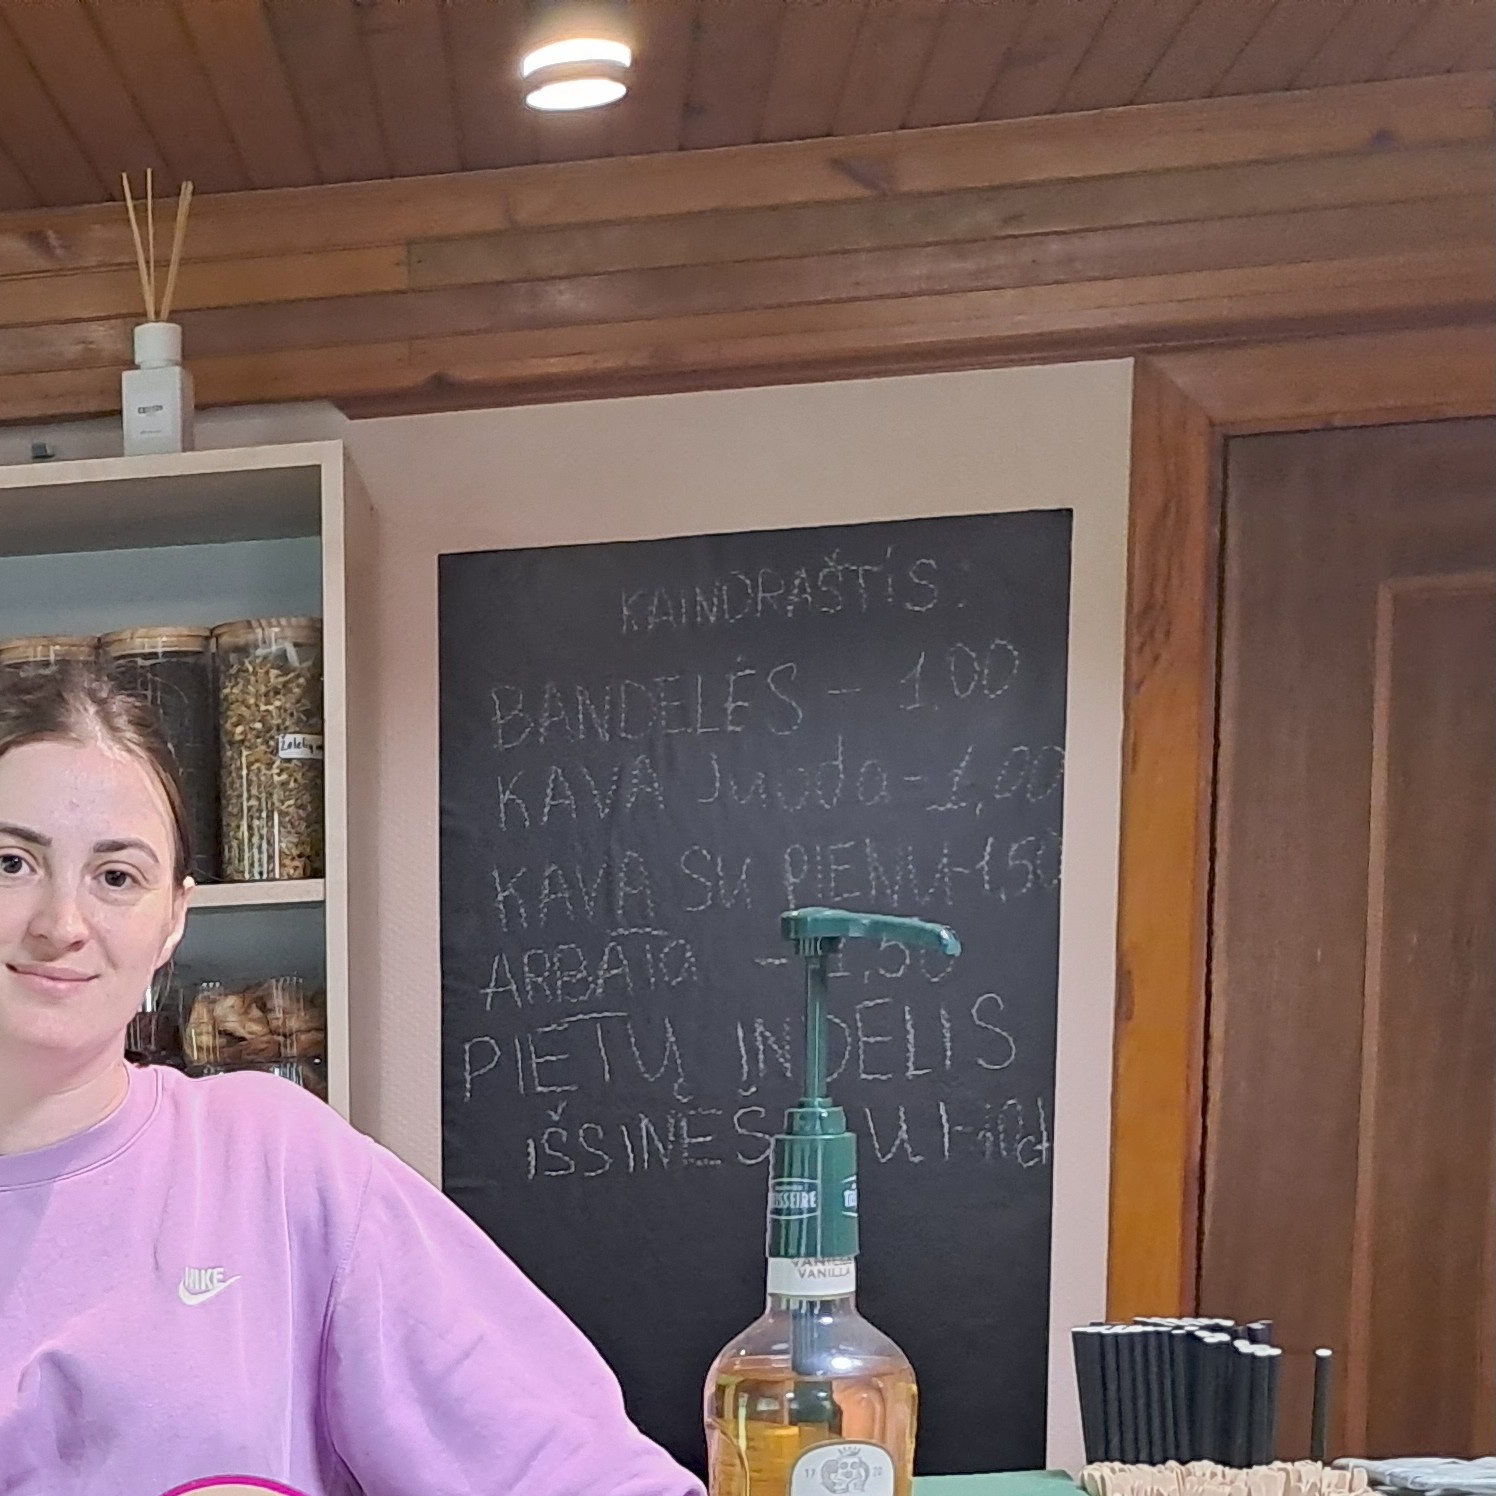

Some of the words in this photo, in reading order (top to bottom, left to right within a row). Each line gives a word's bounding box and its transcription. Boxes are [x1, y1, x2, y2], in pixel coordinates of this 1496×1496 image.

[491, 655, 804, 751] BANDELĖS
[496, 753, 664, 831] KAVA
[493, 849, 657, 932] KAVA
[464, 1011, 694, 1103] PIETŲ
[185, 1266, 224, 1290] NIKE
